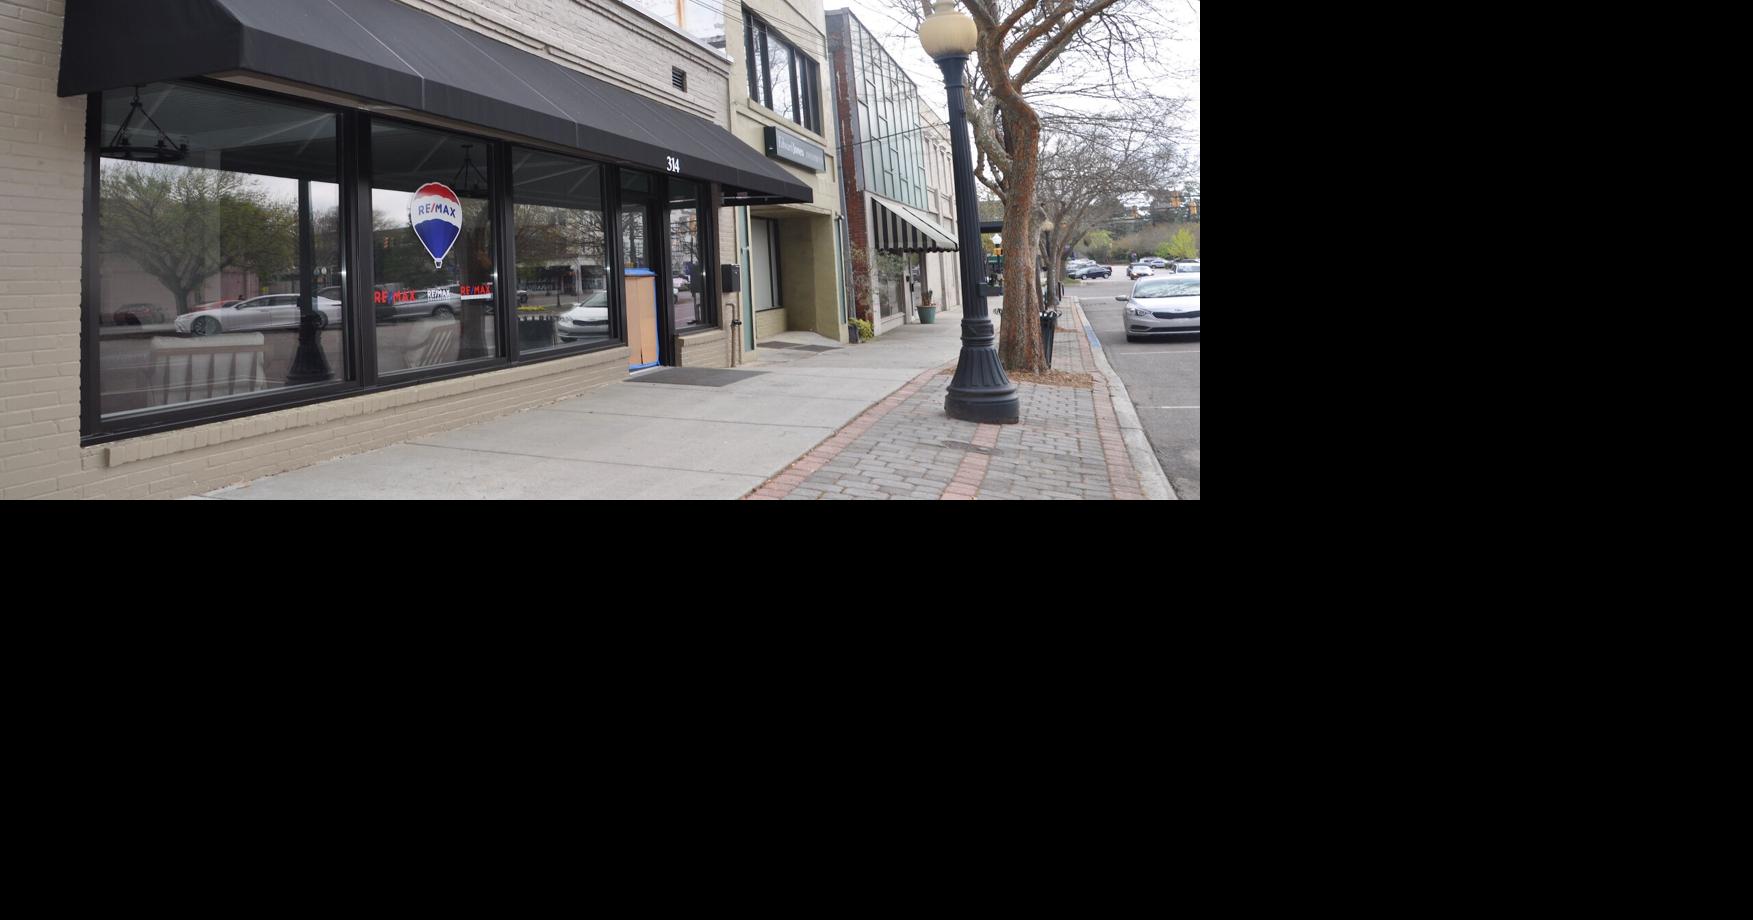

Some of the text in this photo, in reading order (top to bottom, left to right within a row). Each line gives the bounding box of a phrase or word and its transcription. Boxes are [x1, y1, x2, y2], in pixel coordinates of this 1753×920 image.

[666, 155, 680, 173] 314
[418, 202, 456, 218] RE/MAX
[373, 289, 416, 304] RE/MAX
[427, 289, 450, 299] RE/MAX
[460, 284, 490, 296] RE/MAX
